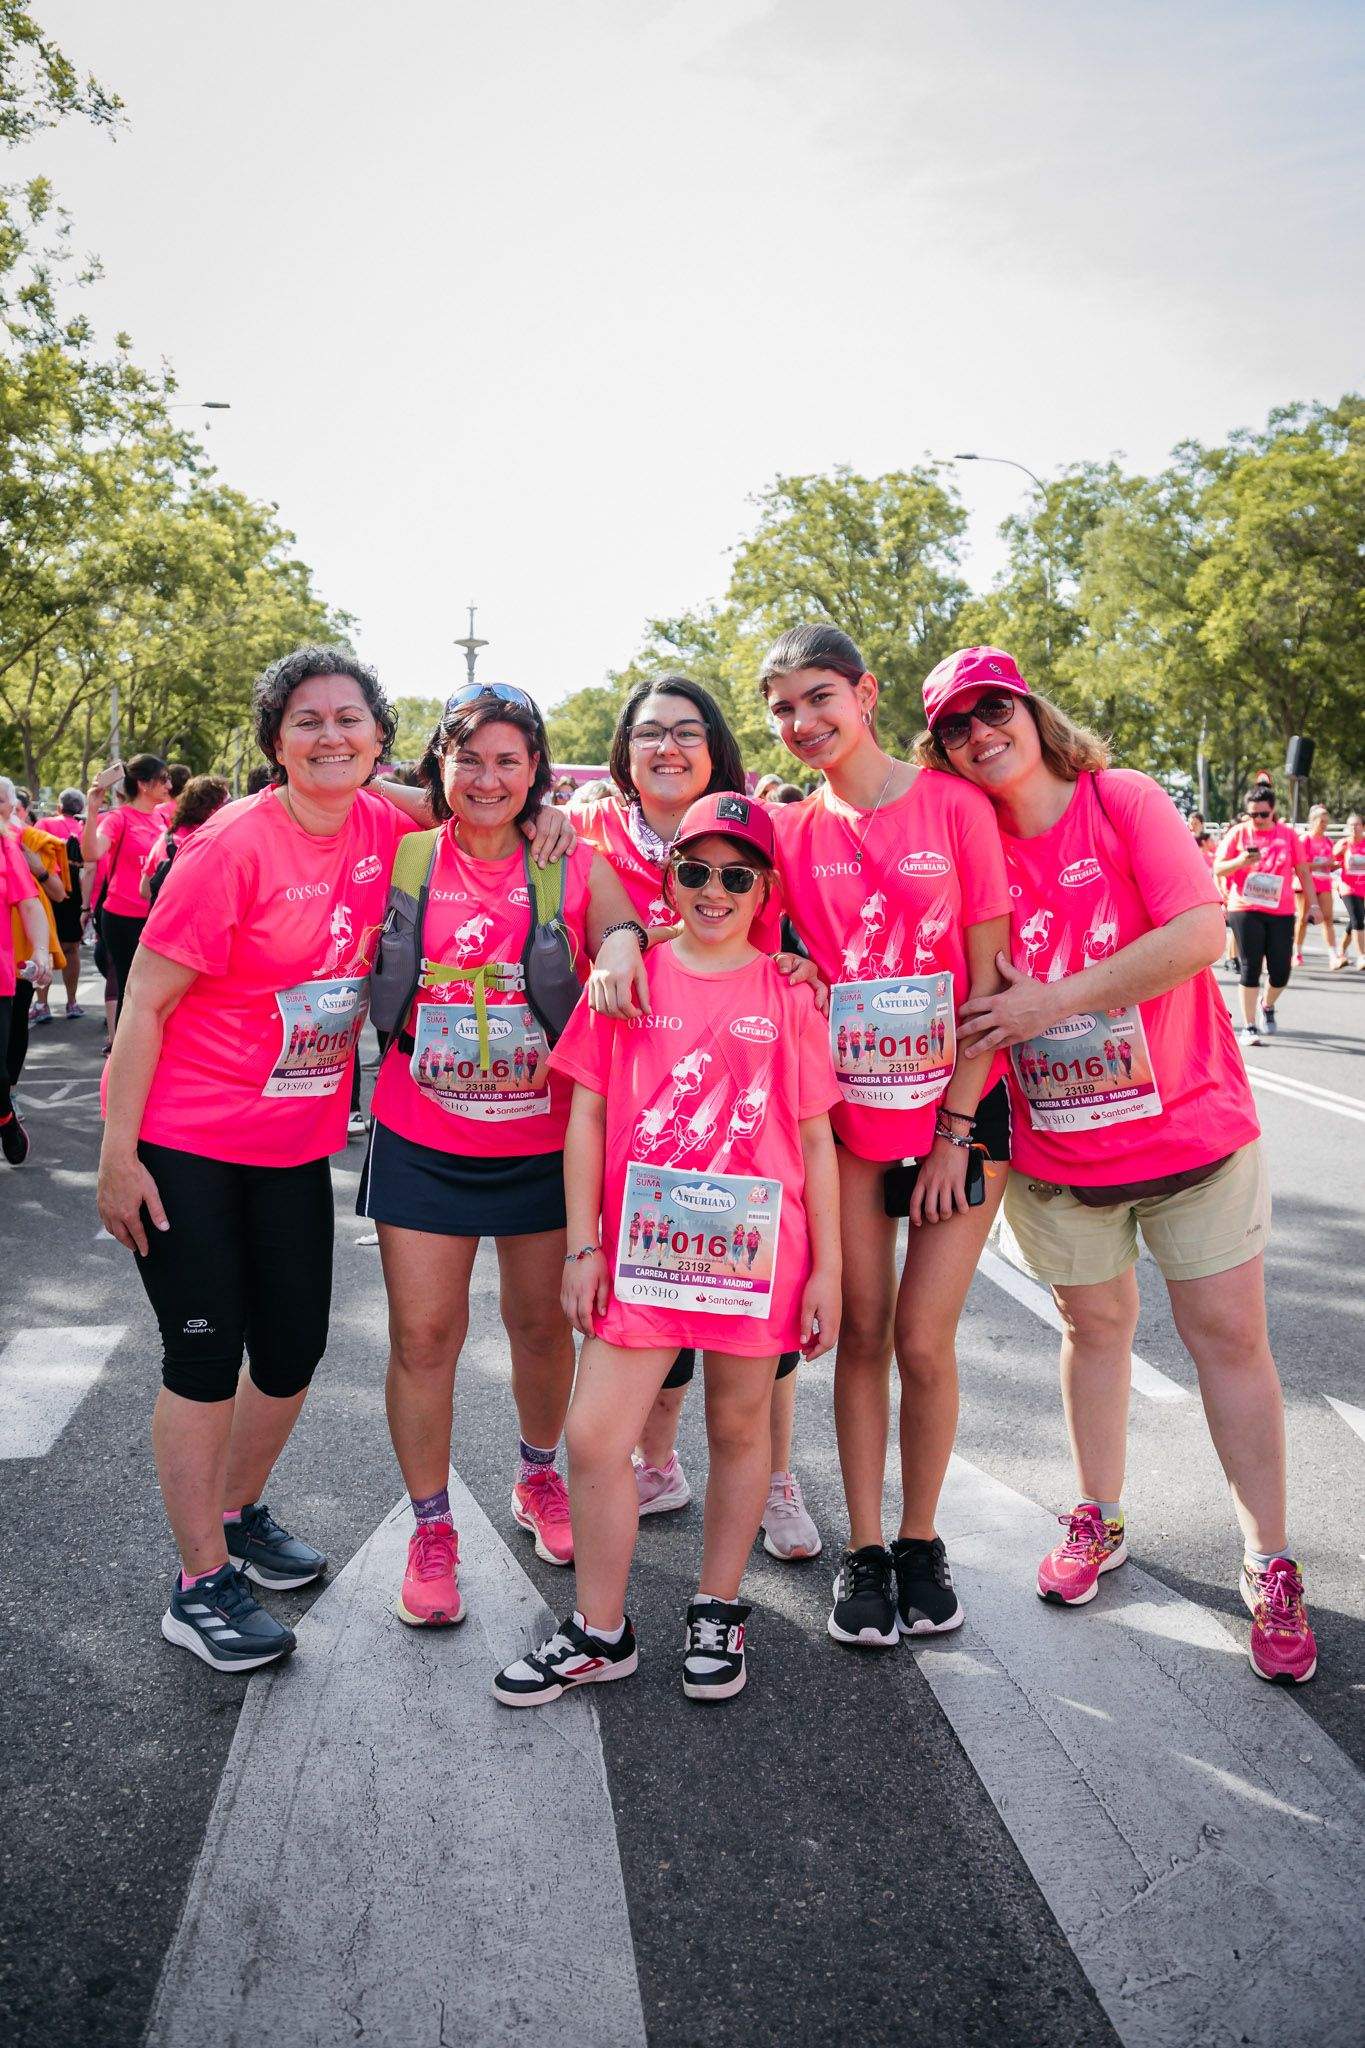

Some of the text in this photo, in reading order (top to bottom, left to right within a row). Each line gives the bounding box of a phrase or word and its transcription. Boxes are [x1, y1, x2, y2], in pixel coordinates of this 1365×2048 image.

[812, 862, 861, 879] OYSHO
[902, 861, 947, 871] ASTURIANA
[286, 882, 330, 901] OYSHO
[428, 888, 467, 901] SHO
[876, 997, 929, 1009] ASTURIANA
[627, 1015, 683, 1031] OYSHO
[316, 1030, 348, 1053] 016
[879, 1034, 929, 1058] 016
[317, 1056, 338, 1066] 23187
[889, 1062, 920, 1073] 23191
[285, 1068, 309, 1076] CARRERA
[309, 1067, 318, 1075] DE
[317, 1066, 325, 1075] LA
[849, 1069, 946, 1084] CARRERA DE LA MUJER MADRID
[1051, 1056, 1104, 1082] 016
[277, 1081, 313, 1091] OYSHO
[465, 1083, 497, 1091] 23188
[1064, 1084, 1095, 1097] 23189
[480, 1092, 503, 1100] MUJER
[508, 1091, 535, 1099] MADRID
[851, 1089, 894, 1101] OYSHO
[1035, 1088, 1139, 1108] CARRERA DE LA MUJER MADRID
[440, 1100, 536, 1116] YSHO Santander
[1101, 1103, 1145, 1119] Santander
[636, 1178, 661, 1188] SUMA
[675, 1190, 731, 1208] ASTURIANA
[671, 1231, 727, 1258] 016
[677, 1261, 711, 1273] 23192
[635, 1268, 754, 1290] CARRERA DE LA MUJER MADRID
[632, 1284, 754, 1308] OYSHO Santander
